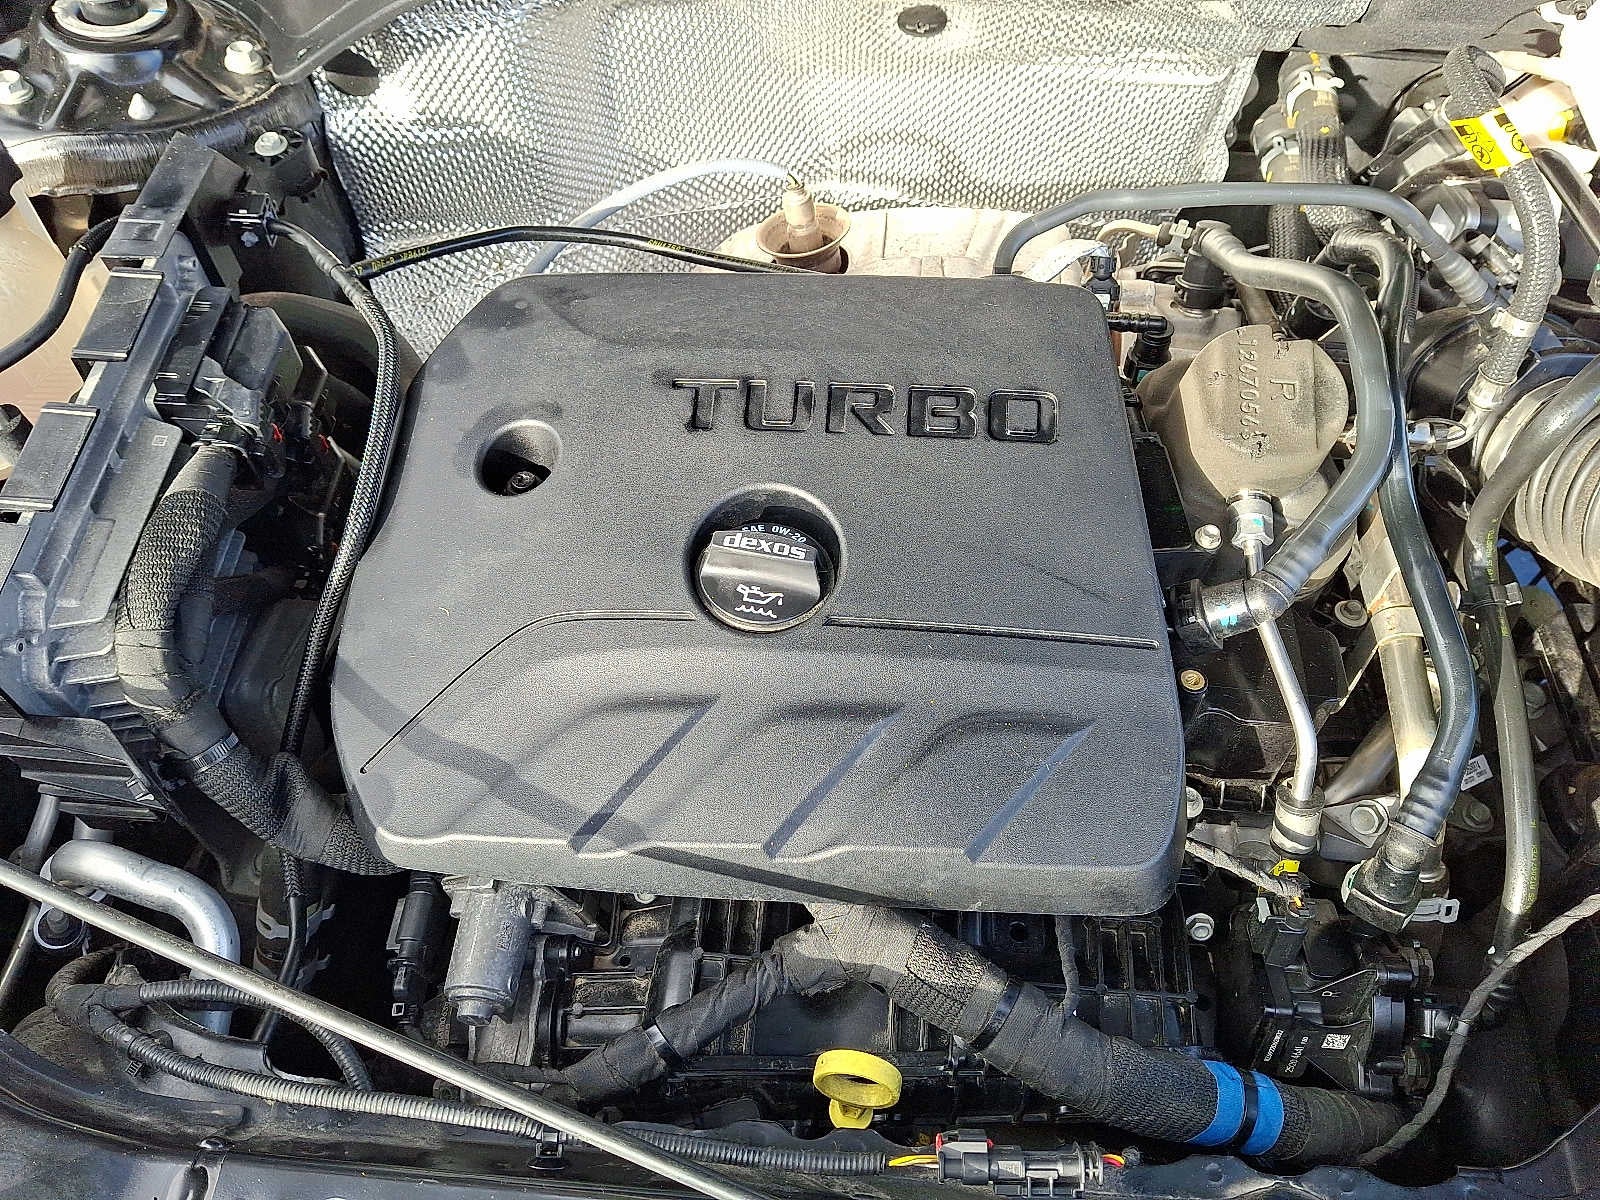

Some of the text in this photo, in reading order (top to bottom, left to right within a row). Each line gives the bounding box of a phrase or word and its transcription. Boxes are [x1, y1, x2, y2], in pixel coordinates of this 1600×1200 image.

[672, 377, 1060, 444] TURBO
[723, 533, 807, 560] dexos
[772, 525, 807, 543] 0W-20
